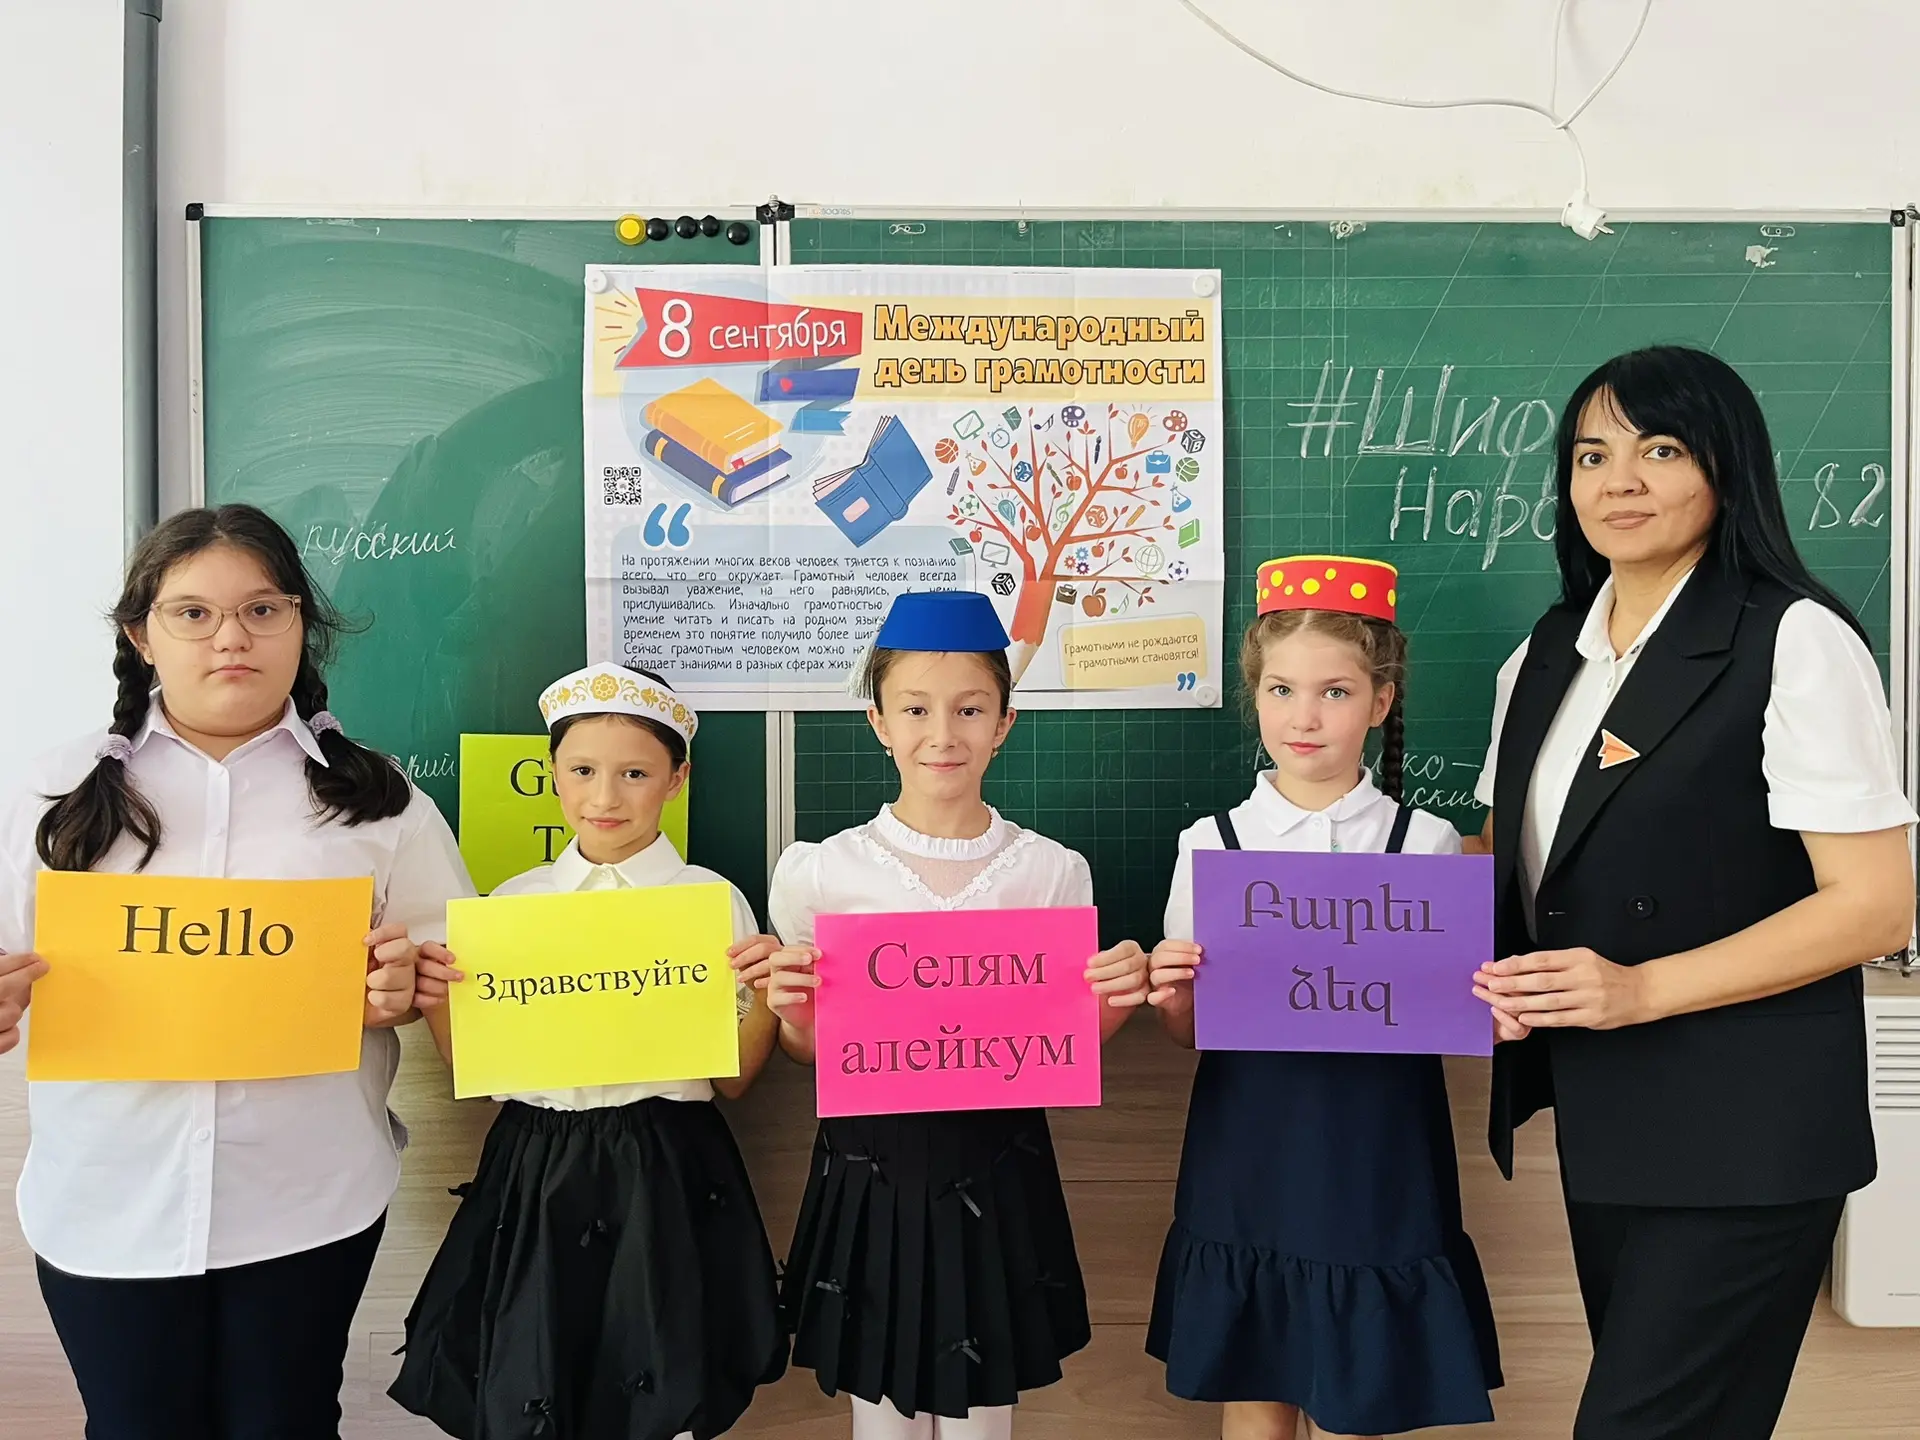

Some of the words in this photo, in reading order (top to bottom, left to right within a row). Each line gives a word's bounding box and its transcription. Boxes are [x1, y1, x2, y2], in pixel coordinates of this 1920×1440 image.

[658, 298, 693, 358] 8
[709, 308, 847, 357] сентября
[874, 304, 1204, 351] Международный
[874, 358, 967, 388] день
[974, 358, 1205, 393] грамотности
[1287, 360, 1558, 498] #Шиф
[622, 554, 635, 566] На
[640, 556, 710, 569] протяжении
[714, 556, 754, 567] многих
[759, 556, 791, 567] веков
[796, 556, 839, 567] человек
[844, 556, 889, 567] тянется
[894, 556, 900, 567] к
[904, 556, 957, 567] познанию
[667, 572, 687, 582] что
[698, 571, 717, 582] его
[728, 571, 784, 584] окружает.
[794, 569, 855, 584] Грамотный
[865, 572, 909, 582] человек
[919, 571, 957, 583] всегда
[622, 585, 669, 595] вызывал
[686, 585, 744, 598] уважение,
[760, 587, 773, 596] на
[789, 586, 815, 596] него
[623, 599, 716, 612] прислушивались.
[729, 599, 790, 610] Изначально
[804, 600, 883, 613] грамотностью
[623, 615, 665, 627] умение
[673, 615, 713, 625] читать
[721, 616, 728, 625] и
[737, 615, 775, 626] писать
[783, 616, 796, 625] на
[805, 615, 847, 628] родном
[623, 630, 680, 642] временем
[685, 630, 705, 640] это
[710, 630, 756, 640] понятие
[761, 630, 812, 643] получило
[817, 627, 849, 640] более
[623, 642, 663, 655] Сейчас
[670, 645, 733, 657] грамотным
[741, 645, 800, 655] человеком
[807, 645, 845, 655] можно
[1064, 641, 1125, 657] Грамотными
[1128, 640, 1139, 649] не
[1142, 633, 1198, 650] рождаются
[1078, 654, 1139, 671] грамотными
[1142, 647, 1199, 663] становятся!
[624, 656, 676, 671] обладает
[680, 660, 732, 670] знаниями
[736, 659, 743, 670] в
[746, 660, 783, 673] разных
[786, 659, 825, 673] сферах
[828, 660, 855, 670] жизн
[533, 825, 573, 863] T
[119, 903, 295, 958] Hello
[867, 942, 1048, 990] Селям
[475, 958, 709, 1005] Здравствуйте
[1288, 964, 1399, 1027] ձեզ
[840, 1024, 1077, 1082] алейкум
